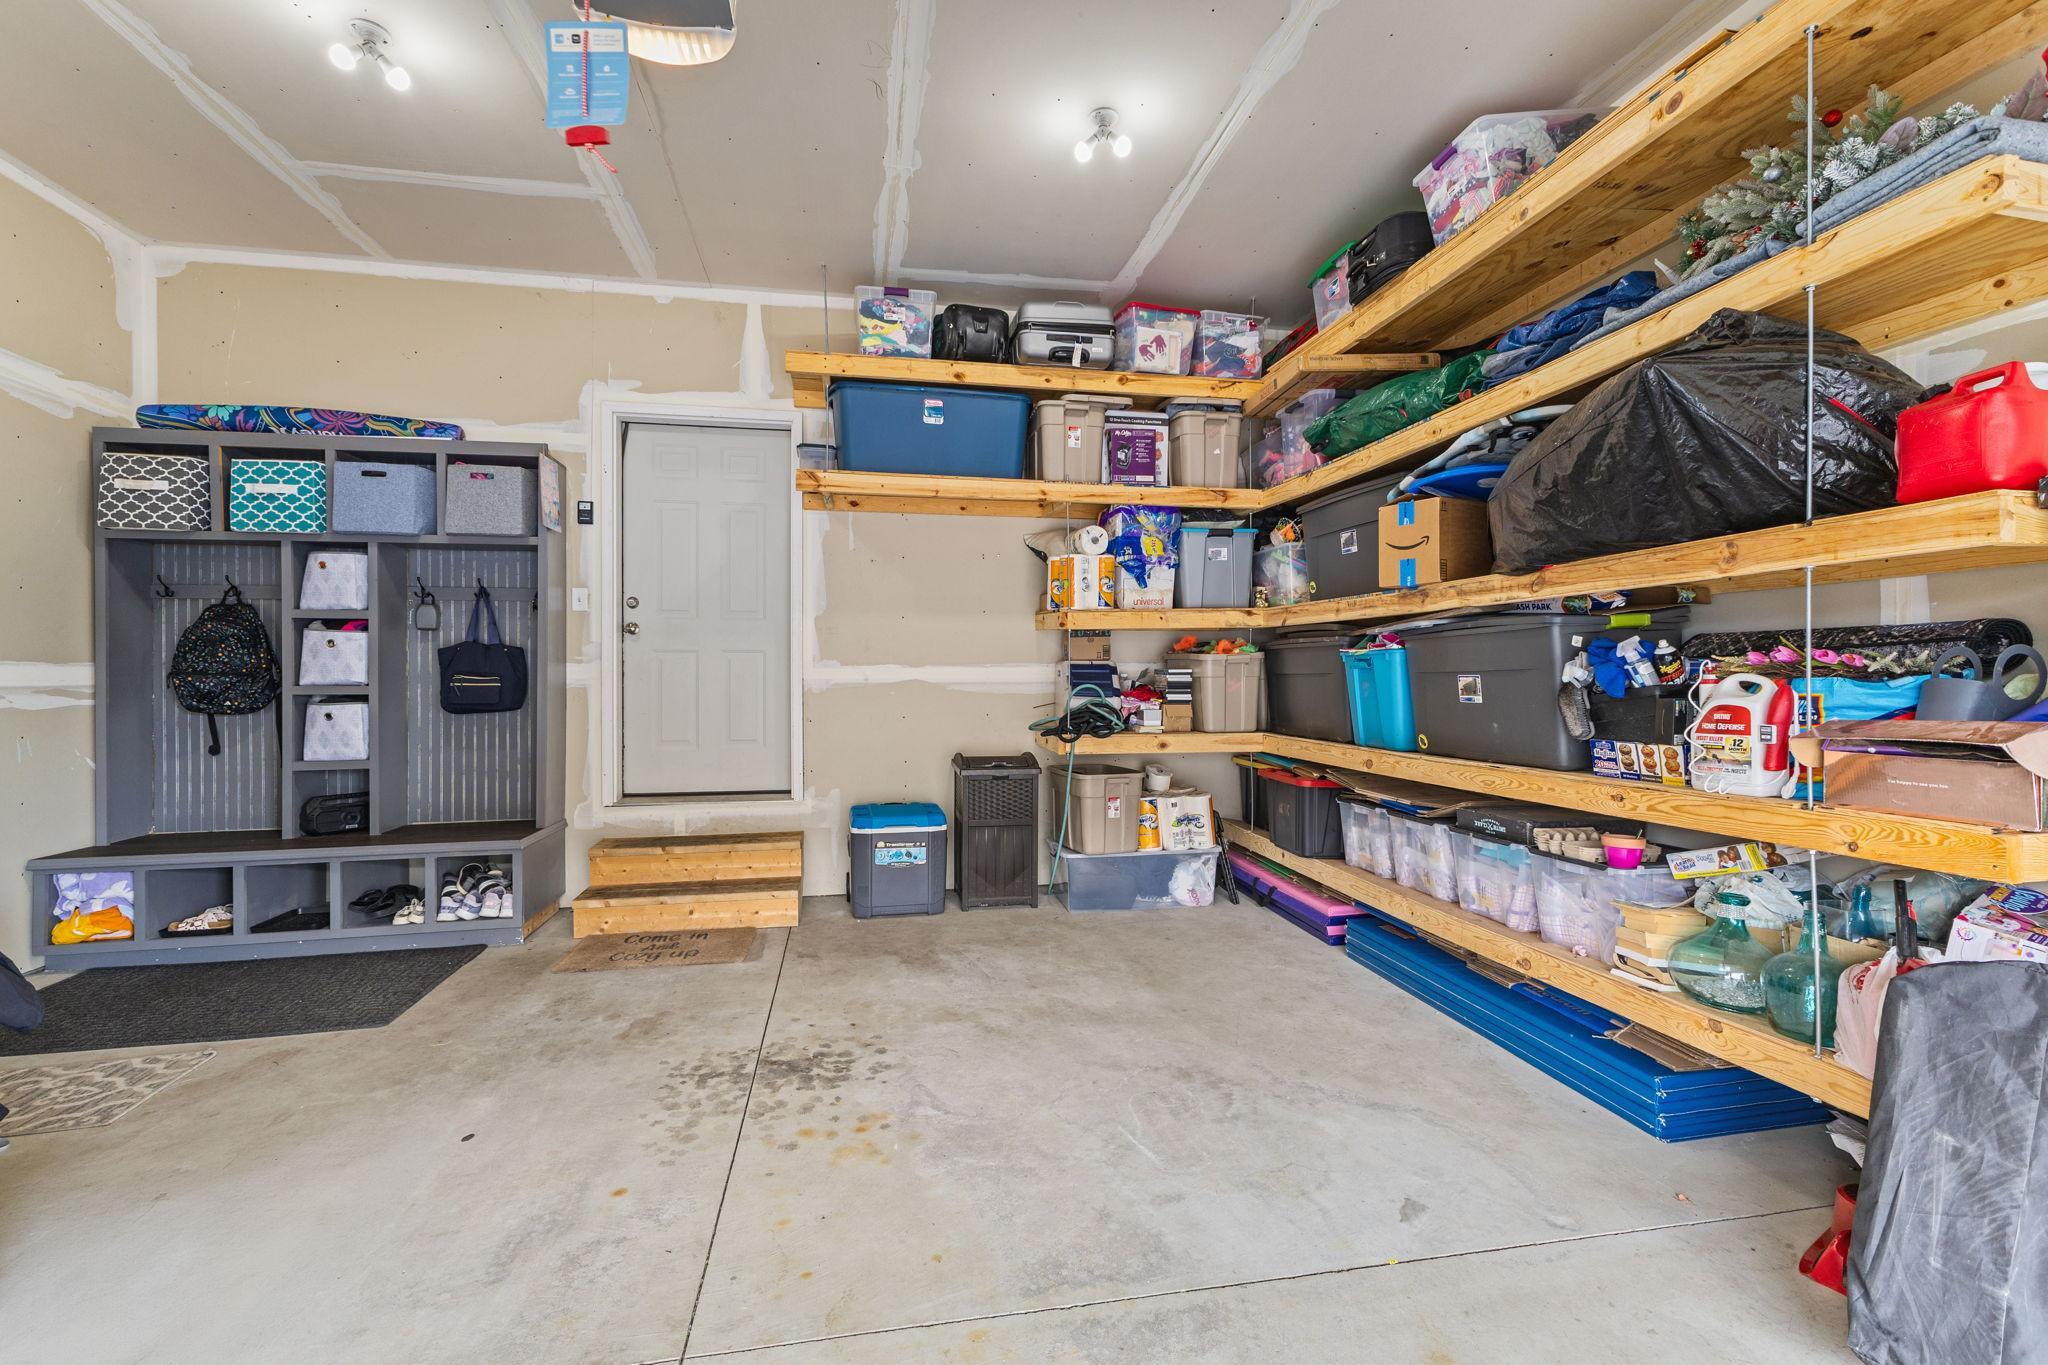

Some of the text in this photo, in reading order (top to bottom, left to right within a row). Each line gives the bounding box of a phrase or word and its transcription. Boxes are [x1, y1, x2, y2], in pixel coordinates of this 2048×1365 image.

[1133, 597, 1165, 606] universal
[1515, 602, 1552, 611] ASH PARK
[1701, 722, 1746, 731] HOME DEFENSE
[1732, 738, 1744, 748] 12
[624, 931, 709, 944] Come in
[608, 949, 700, 963] Cozy up
